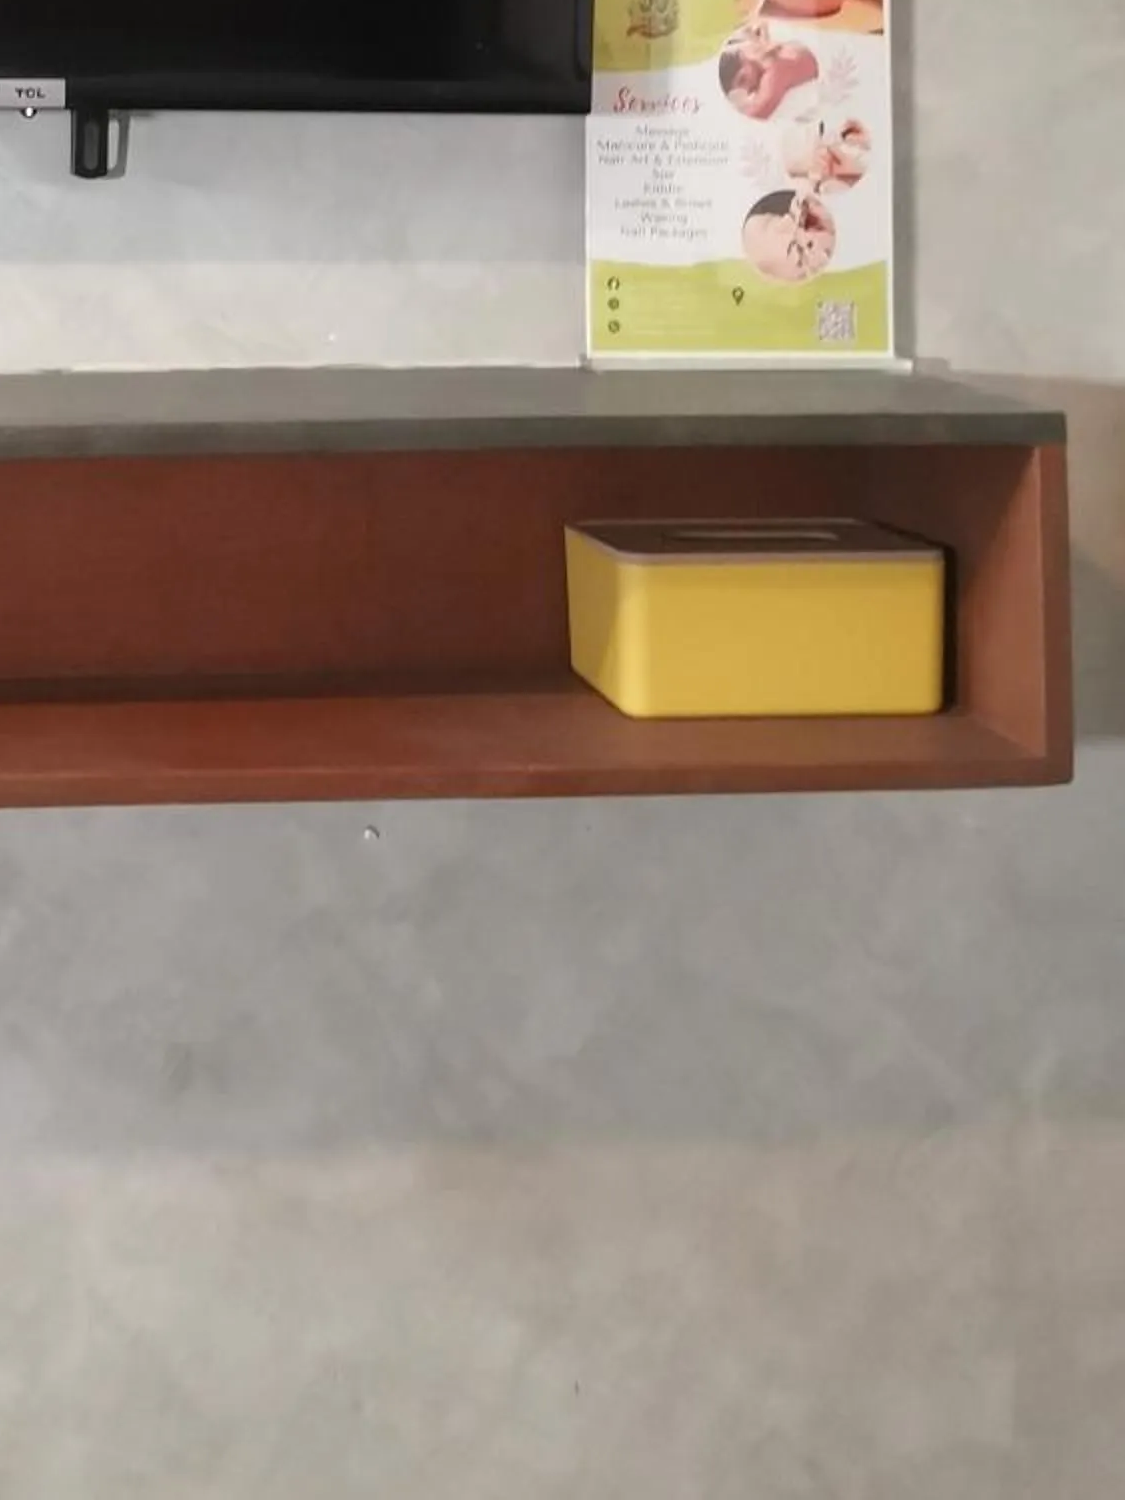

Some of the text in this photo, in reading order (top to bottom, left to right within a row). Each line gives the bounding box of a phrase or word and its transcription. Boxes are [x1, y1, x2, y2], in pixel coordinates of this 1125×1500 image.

[15, 87, 46, 99] TCL
[613, 86, 700, 113] Services
[596, 139, 656, 151] Manicure
[630, 154, 649, 165] Art
